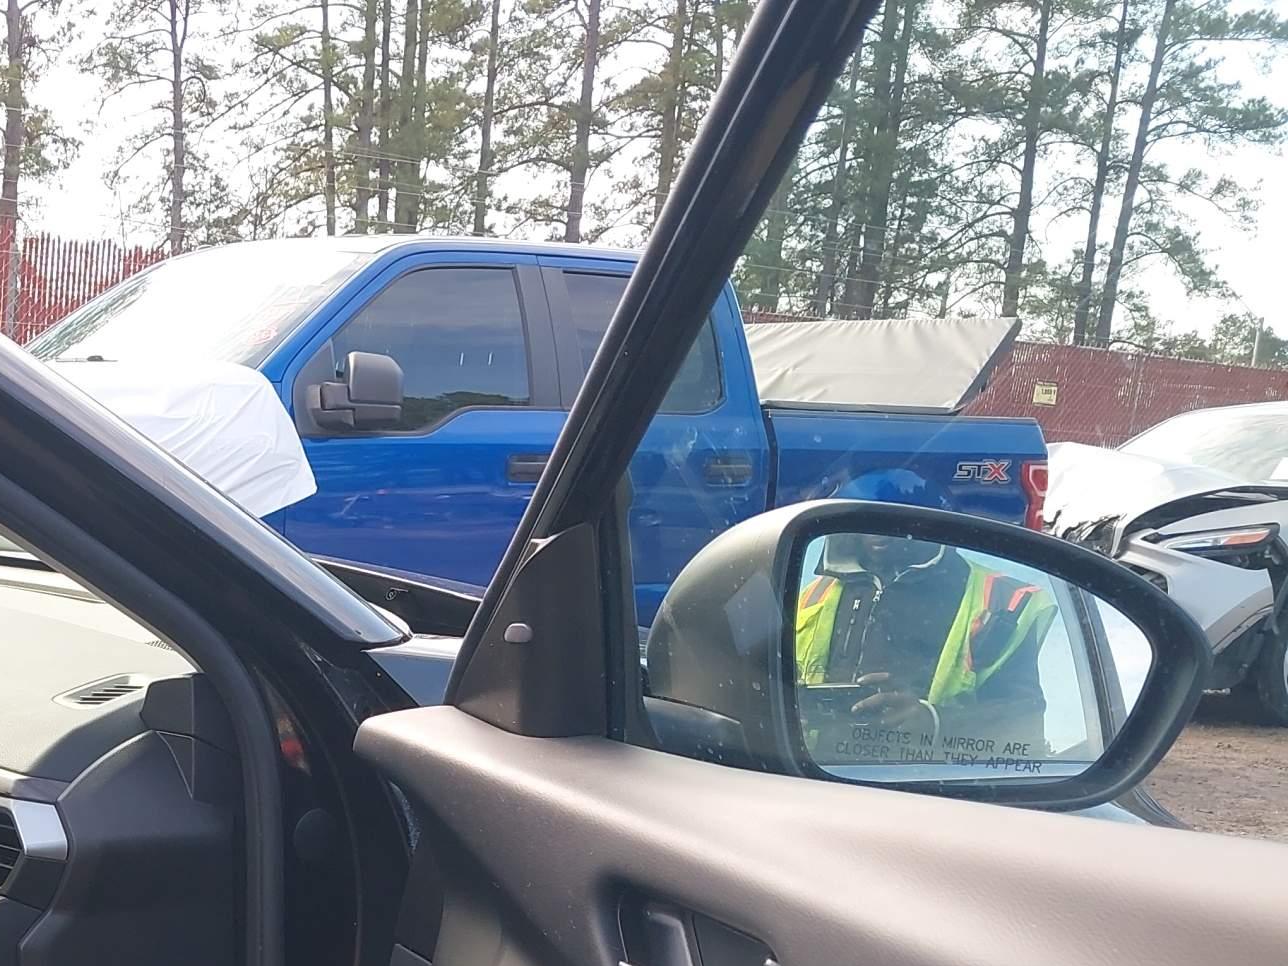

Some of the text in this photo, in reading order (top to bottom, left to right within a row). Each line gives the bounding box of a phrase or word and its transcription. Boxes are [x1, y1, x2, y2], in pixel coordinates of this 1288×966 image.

[953, 459, 1012, 484] STX
[851, 728, 1032, 757] OBJECTS IN MIRROR ARE
[836, 741, 1043, 774] CLOSER THAN THEY APPEAR
